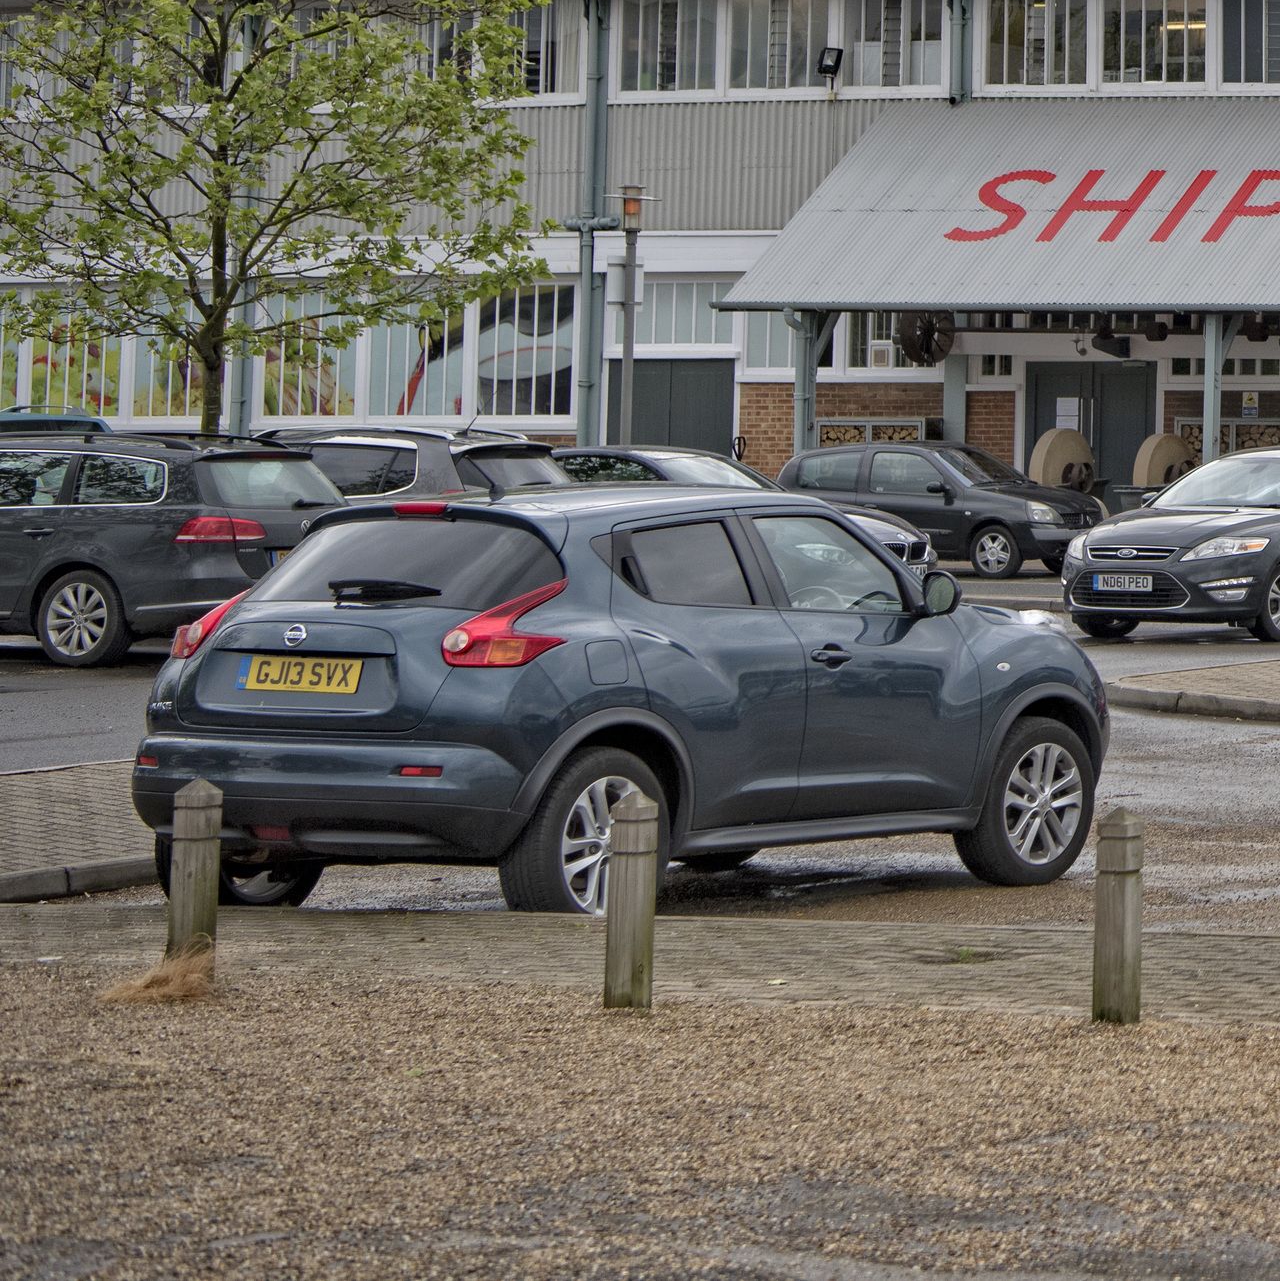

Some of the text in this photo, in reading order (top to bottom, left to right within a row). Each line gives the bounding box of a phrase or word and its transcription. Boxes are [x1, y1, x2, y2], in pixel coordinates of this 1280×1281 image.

[1102, 576, 1126, 589] ND61
[1128, 576, 1149, 589] PEO
[255, 660, 305, 686] GJ13
[308, 661, 354, 688] SVX
